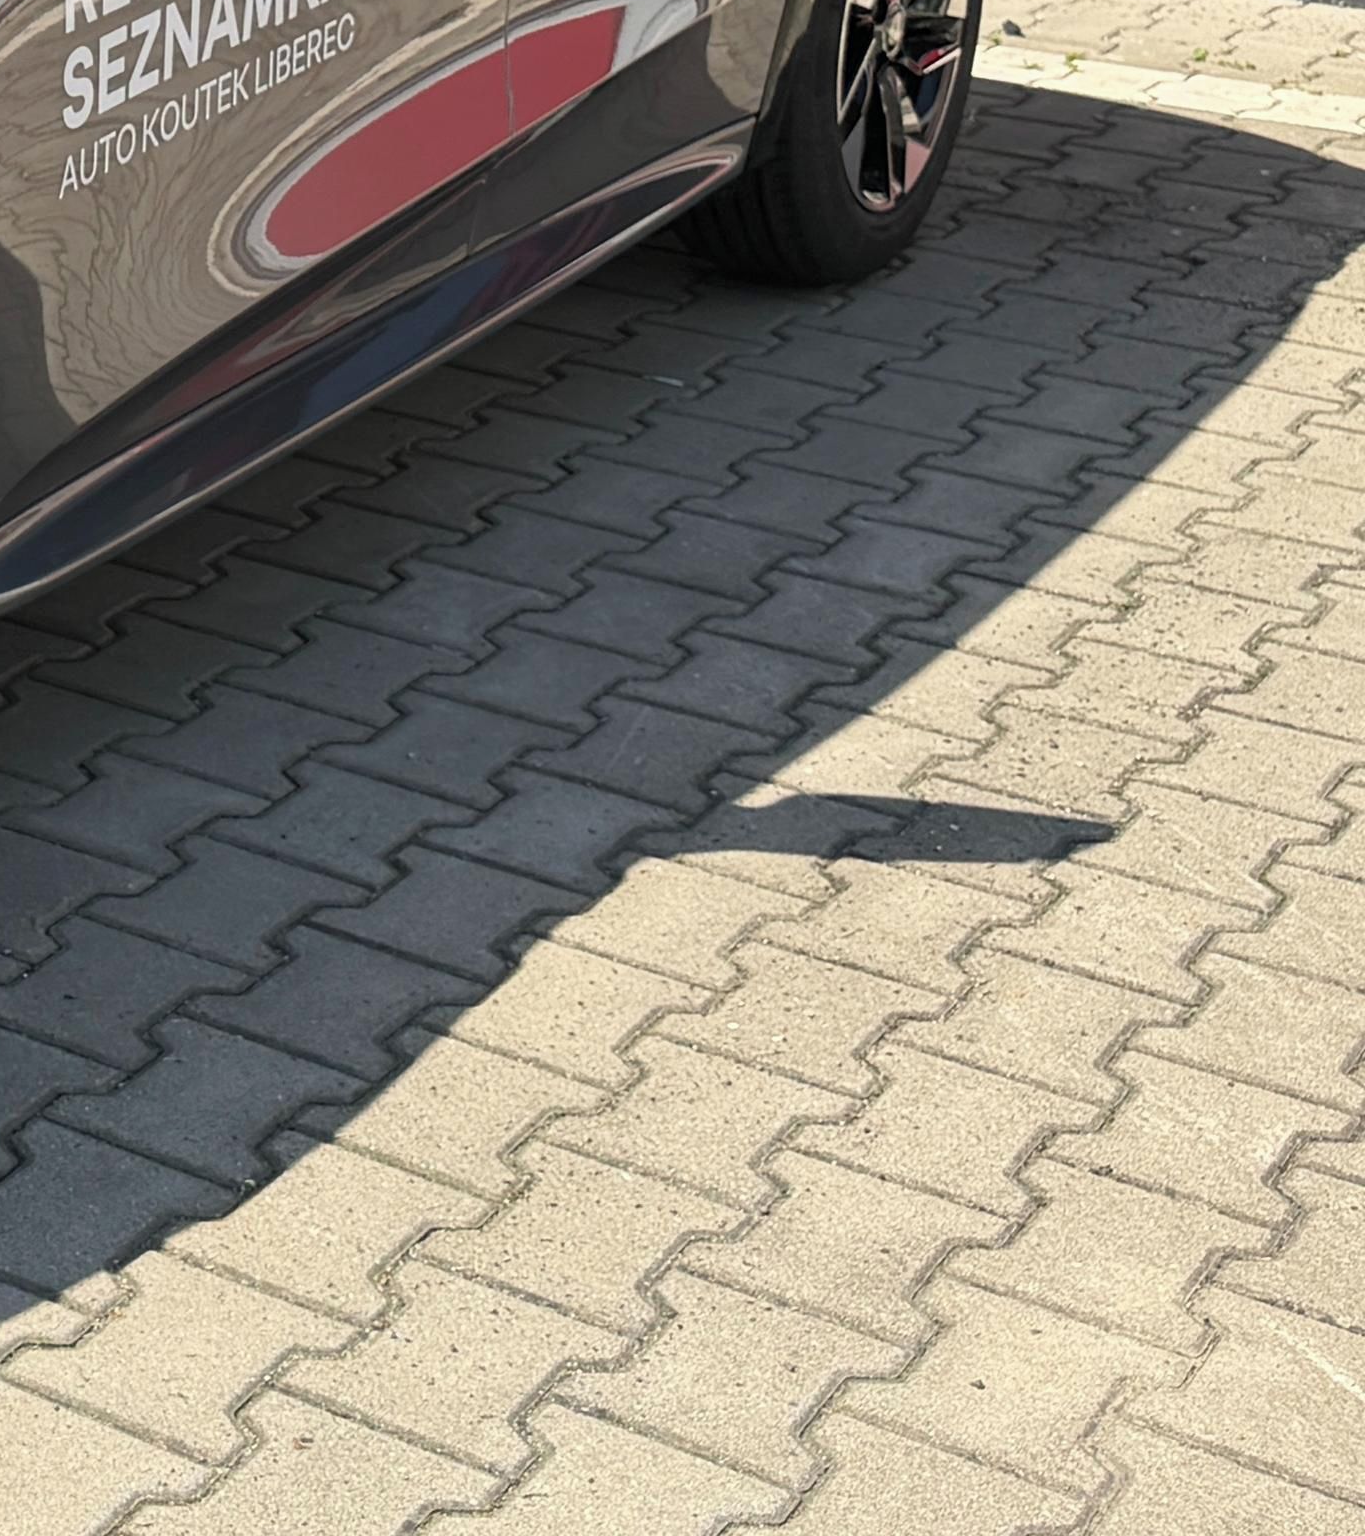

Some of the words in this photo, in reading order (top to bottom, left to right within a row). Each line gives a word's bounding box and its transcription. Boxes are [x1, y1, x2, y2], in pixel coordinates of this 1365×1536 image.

[58, 122, 138, 200] AUTO
[142, 62, 251, 153] KOUTEK
[254, 13, 356, 95] LIBEREC
